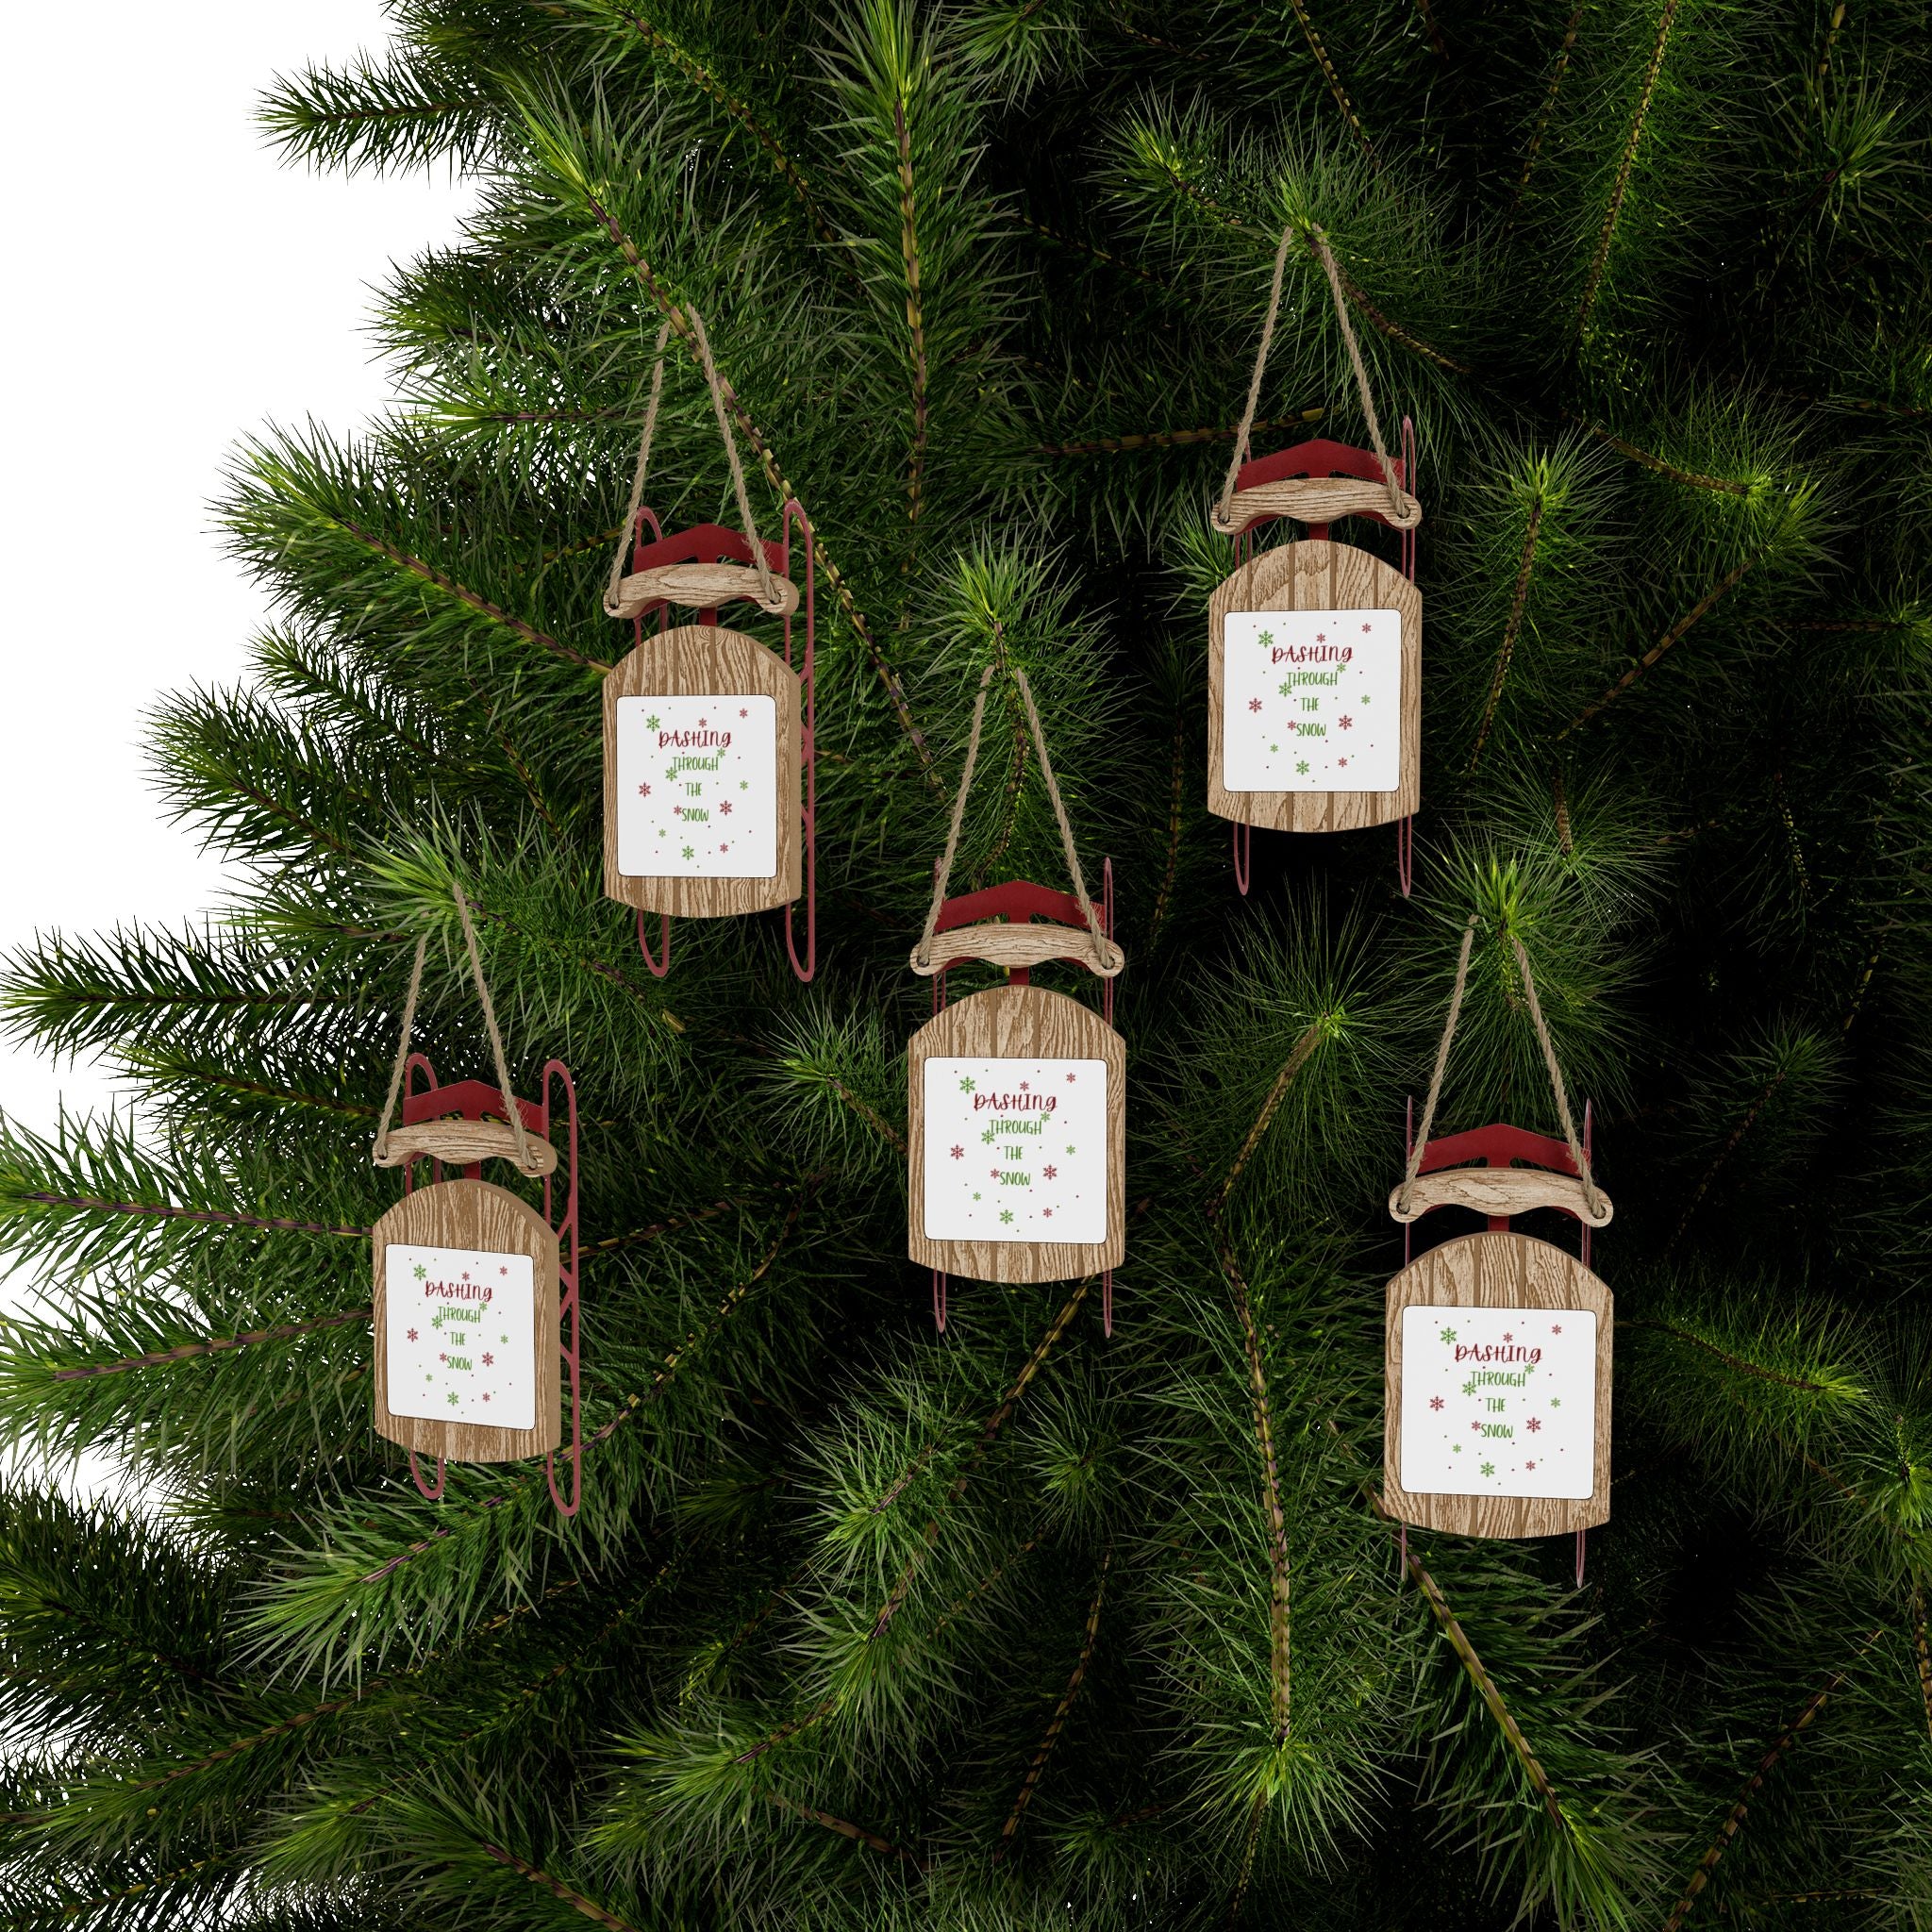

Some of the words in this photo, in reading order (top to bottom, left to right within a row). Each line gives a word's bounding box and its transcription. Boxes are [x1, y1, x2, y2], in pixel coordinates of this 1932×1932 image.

[1286, 672, 1338, 686] THROUGH
[1300, 697, 1319, 711] THE
[1296, 723, 1326, 737] SNOW
[672, 757, 719, 771] THROUGH
[685, 782, 702, 796] THE
[681, 808, 708, 822] SNOW
[989, 1120, 1041, 1135] THROUGH
[1004, 1145, 1024, 1160] THE
[999, 1172, 1031, 1186] SNOW
[438, 1306, 480, 1323] THROUGH
[450, 1332, 466, 1345] THE
[446, 1357, 472, 1371] SNOW
[1470, 1372, 1525, 1387] THROUGH
[1486, 1398, 1506, 1412] THE
[1481, 1424, 1513, 1438] SNOW
